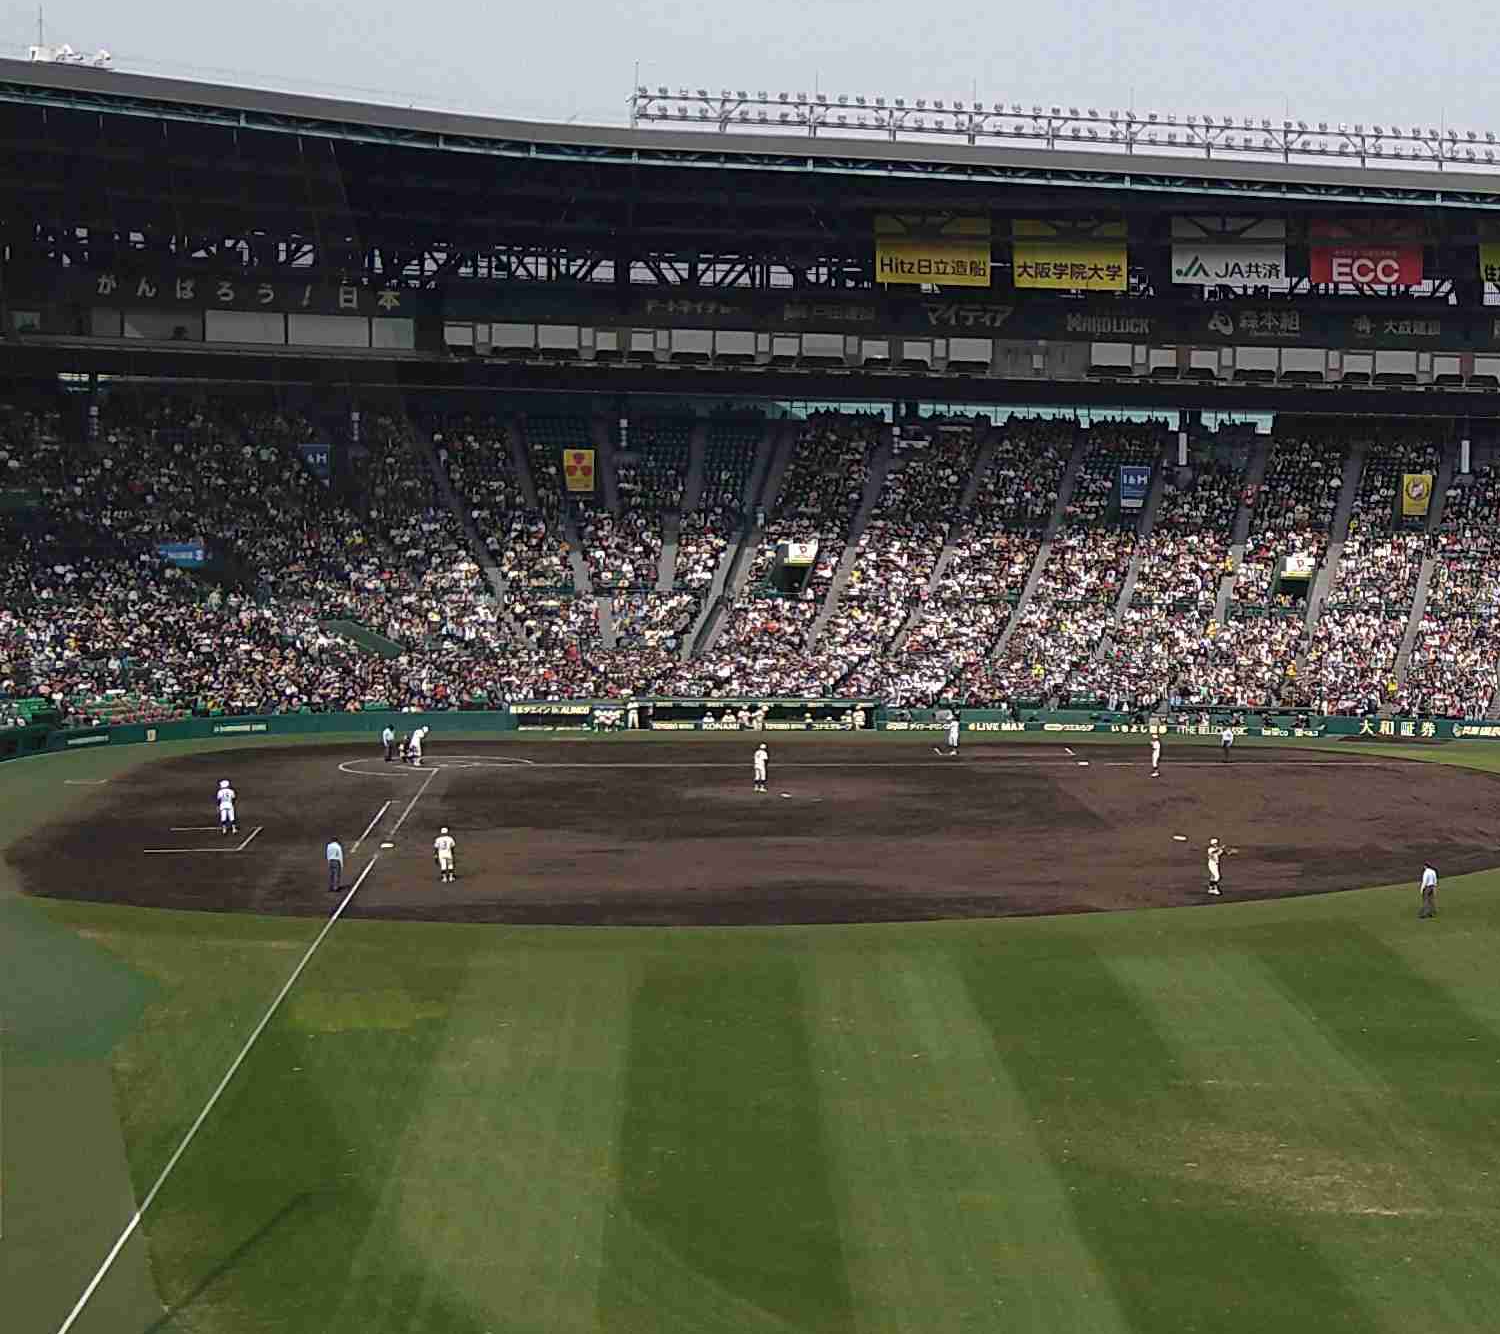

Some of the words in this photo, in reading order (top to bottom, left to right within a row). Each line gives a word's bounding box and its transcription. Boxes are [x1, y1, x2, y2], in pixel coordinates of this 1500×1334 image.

[880, 257, 986, 278] Hitz日立造船
[1016, 263, 1123, 282] 大阪学院大学
[1214, 263, 1281, 280] JA共済
[1332, 259, 1400, 282] ECC
[702, 722, 740, 730] KONAMI
[976, 722, 999, 731] LIVE
[1001, 722, 1025, 731] MAX
[1359, 715, 1437, 738] 大和証券
